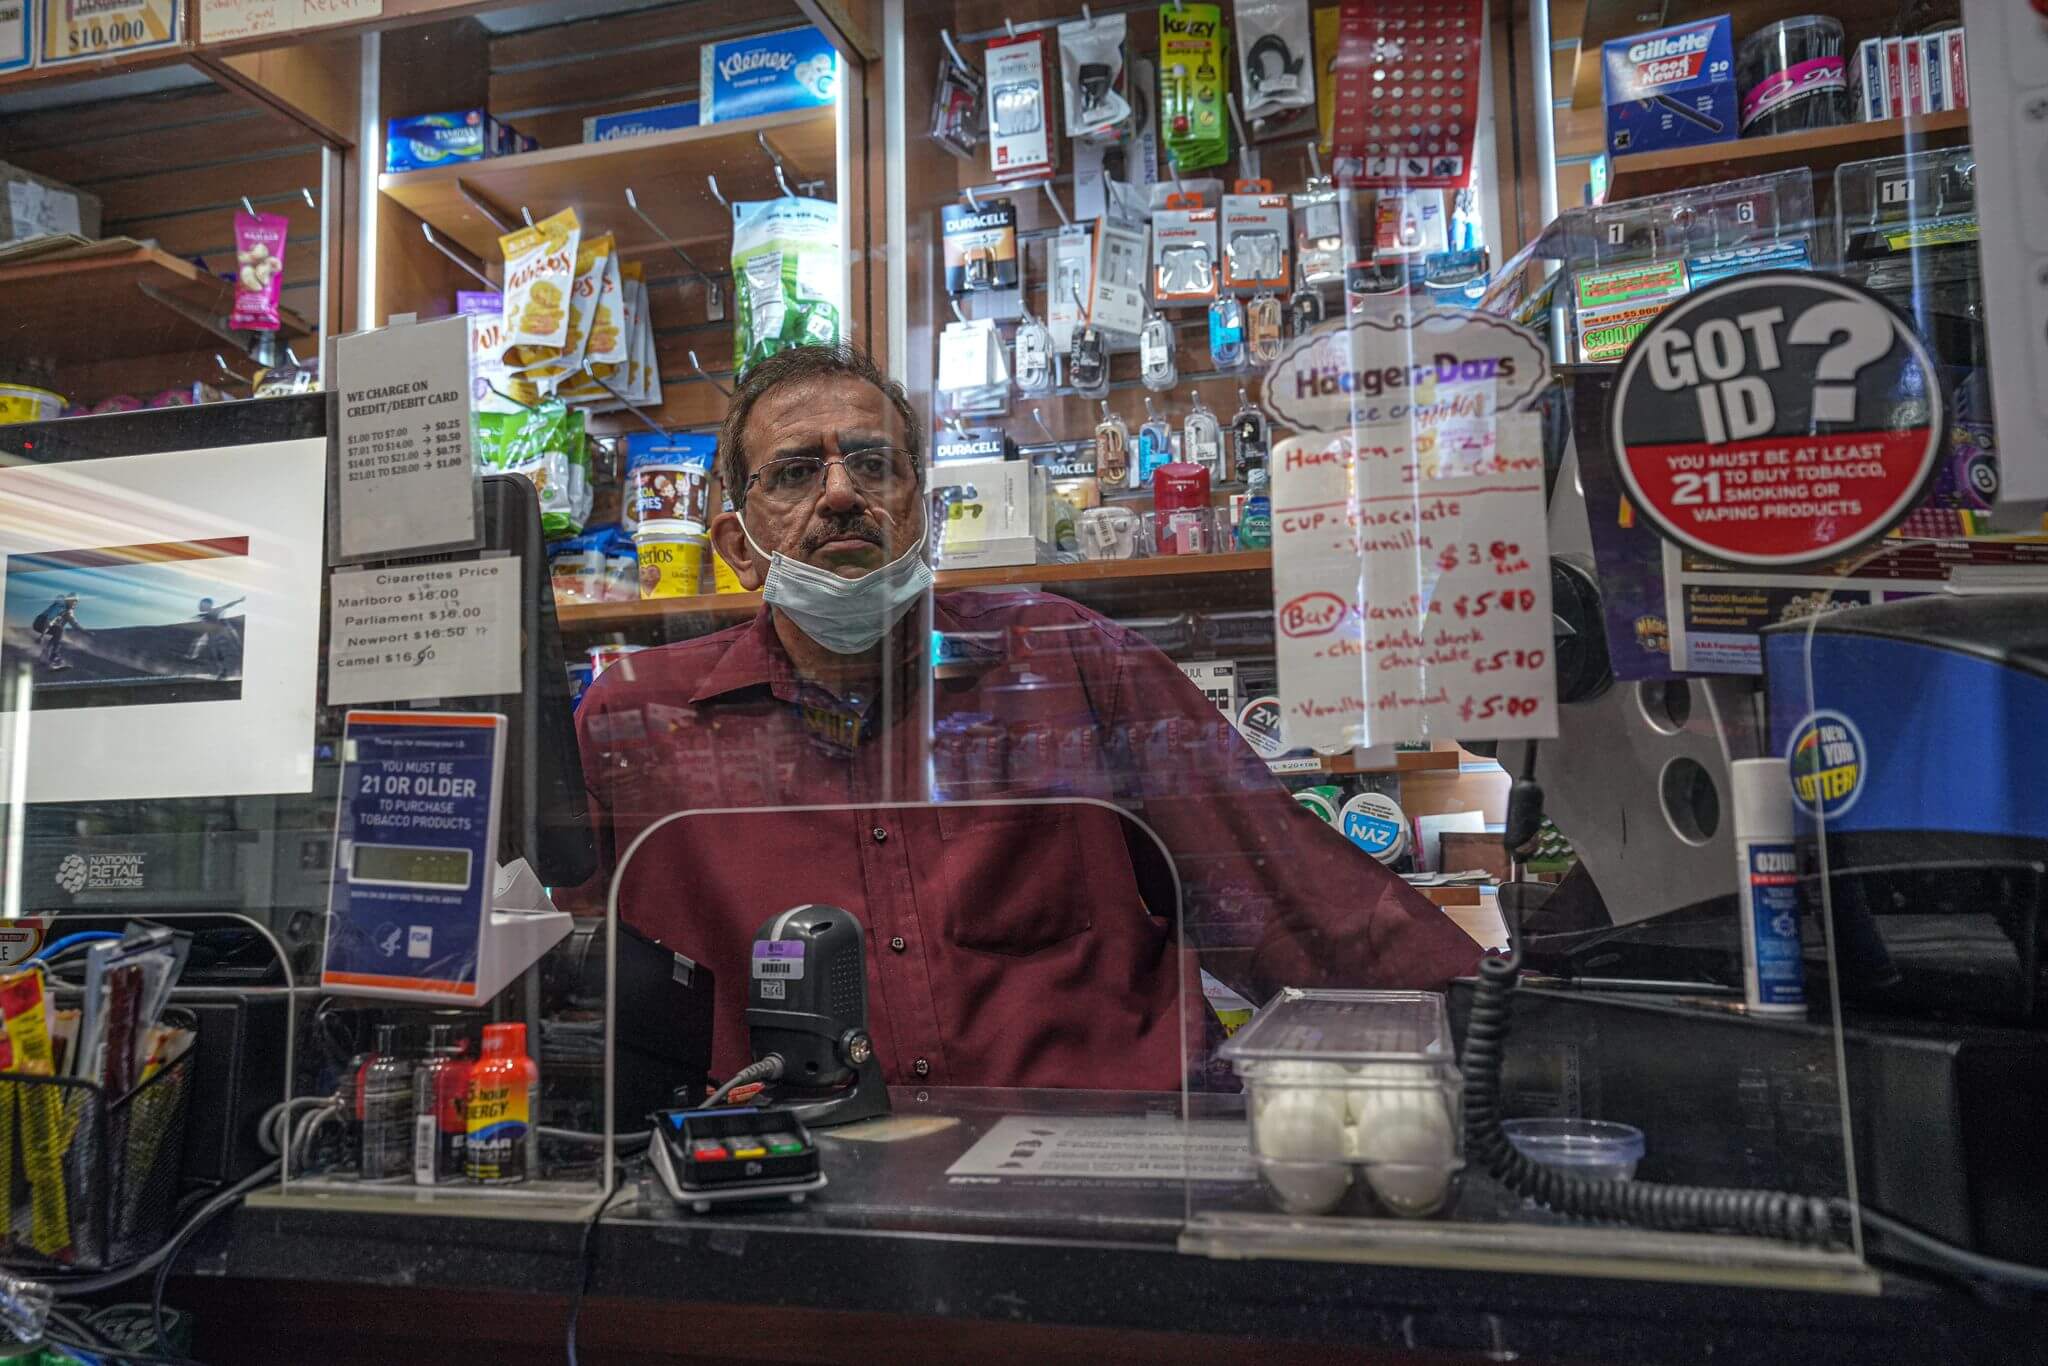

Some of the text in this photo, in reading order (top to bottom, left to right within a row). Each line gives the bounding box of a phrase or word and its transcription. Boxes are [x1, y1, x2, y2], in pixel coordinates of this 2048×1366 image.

[68, 19, 144, 50] $10,000
[1629, 33, 1709, 62] Gillette
[719, 50, 792, 82] Kleenex
[1648, 55, 1689, 73] Good
[1709, 60, 1729, 73] 30
[1740, 203, 1751, 220] 6
[945, 212, 1009, 231] DURACELL
[1611, 226, 1622, 243] 1
[1649, 308, 1783, 391] GOT
[1787, 300, 1894, 422] ?
[347, 380, 428, 403] WE CHARGE ON
[347, 391, 459, 418] CREDIT/DEBIT CARD
[1696, 376, 1775, 443] ID
[371, 431, 384, 440] TO
[435, 419, 460, 431] $0.25
[372, 444, 385, 453] TO
[436, 432, 461, 444] $0.50
[937, 441, 1001, 457] DURACELL
[377, 456, 390, 465] TO
[1667, 443, 1884, 470] YOU MUST BE AT LEAST
[378, 468, 390, 477] TO
[437, 457, 462, 469] $1.00
[1049, 463, 1095, 476] RACELL
[1725, 462, 1887, 485] TO BUY TOBACCO,
[1671, 471, 1721, 505] 21
[1725, 482, 1840, 502] SMOKING OR
[1692, 500, 1862, 522] VAPING PRODUCTS
[639, 548, 673, 564] eerios
[376, 566, 499, 585] Cigarettes Price
[337, 593, 402, 608] Marlboro
[344, 612, 424, 627] Parliament
[347, 633, 408, 648] Newport
[1820, 725, 1847, 742] NEW
[382, 760, 454, 775] YOU MUST BE
[360, 775, 477, 798] 21 OR OLDER
[380, 799, 455, 814] TO PURCHASE
[360, 813, 473, 830] TOBACCO PRODUCTS
[1350, 823, 1391, 847] ZYN
[90, 855, 144, 864] NATIONAL
[89, 864, 144, 877] RETAIL
[88, 878, 144, 887] SOLUTIONS
